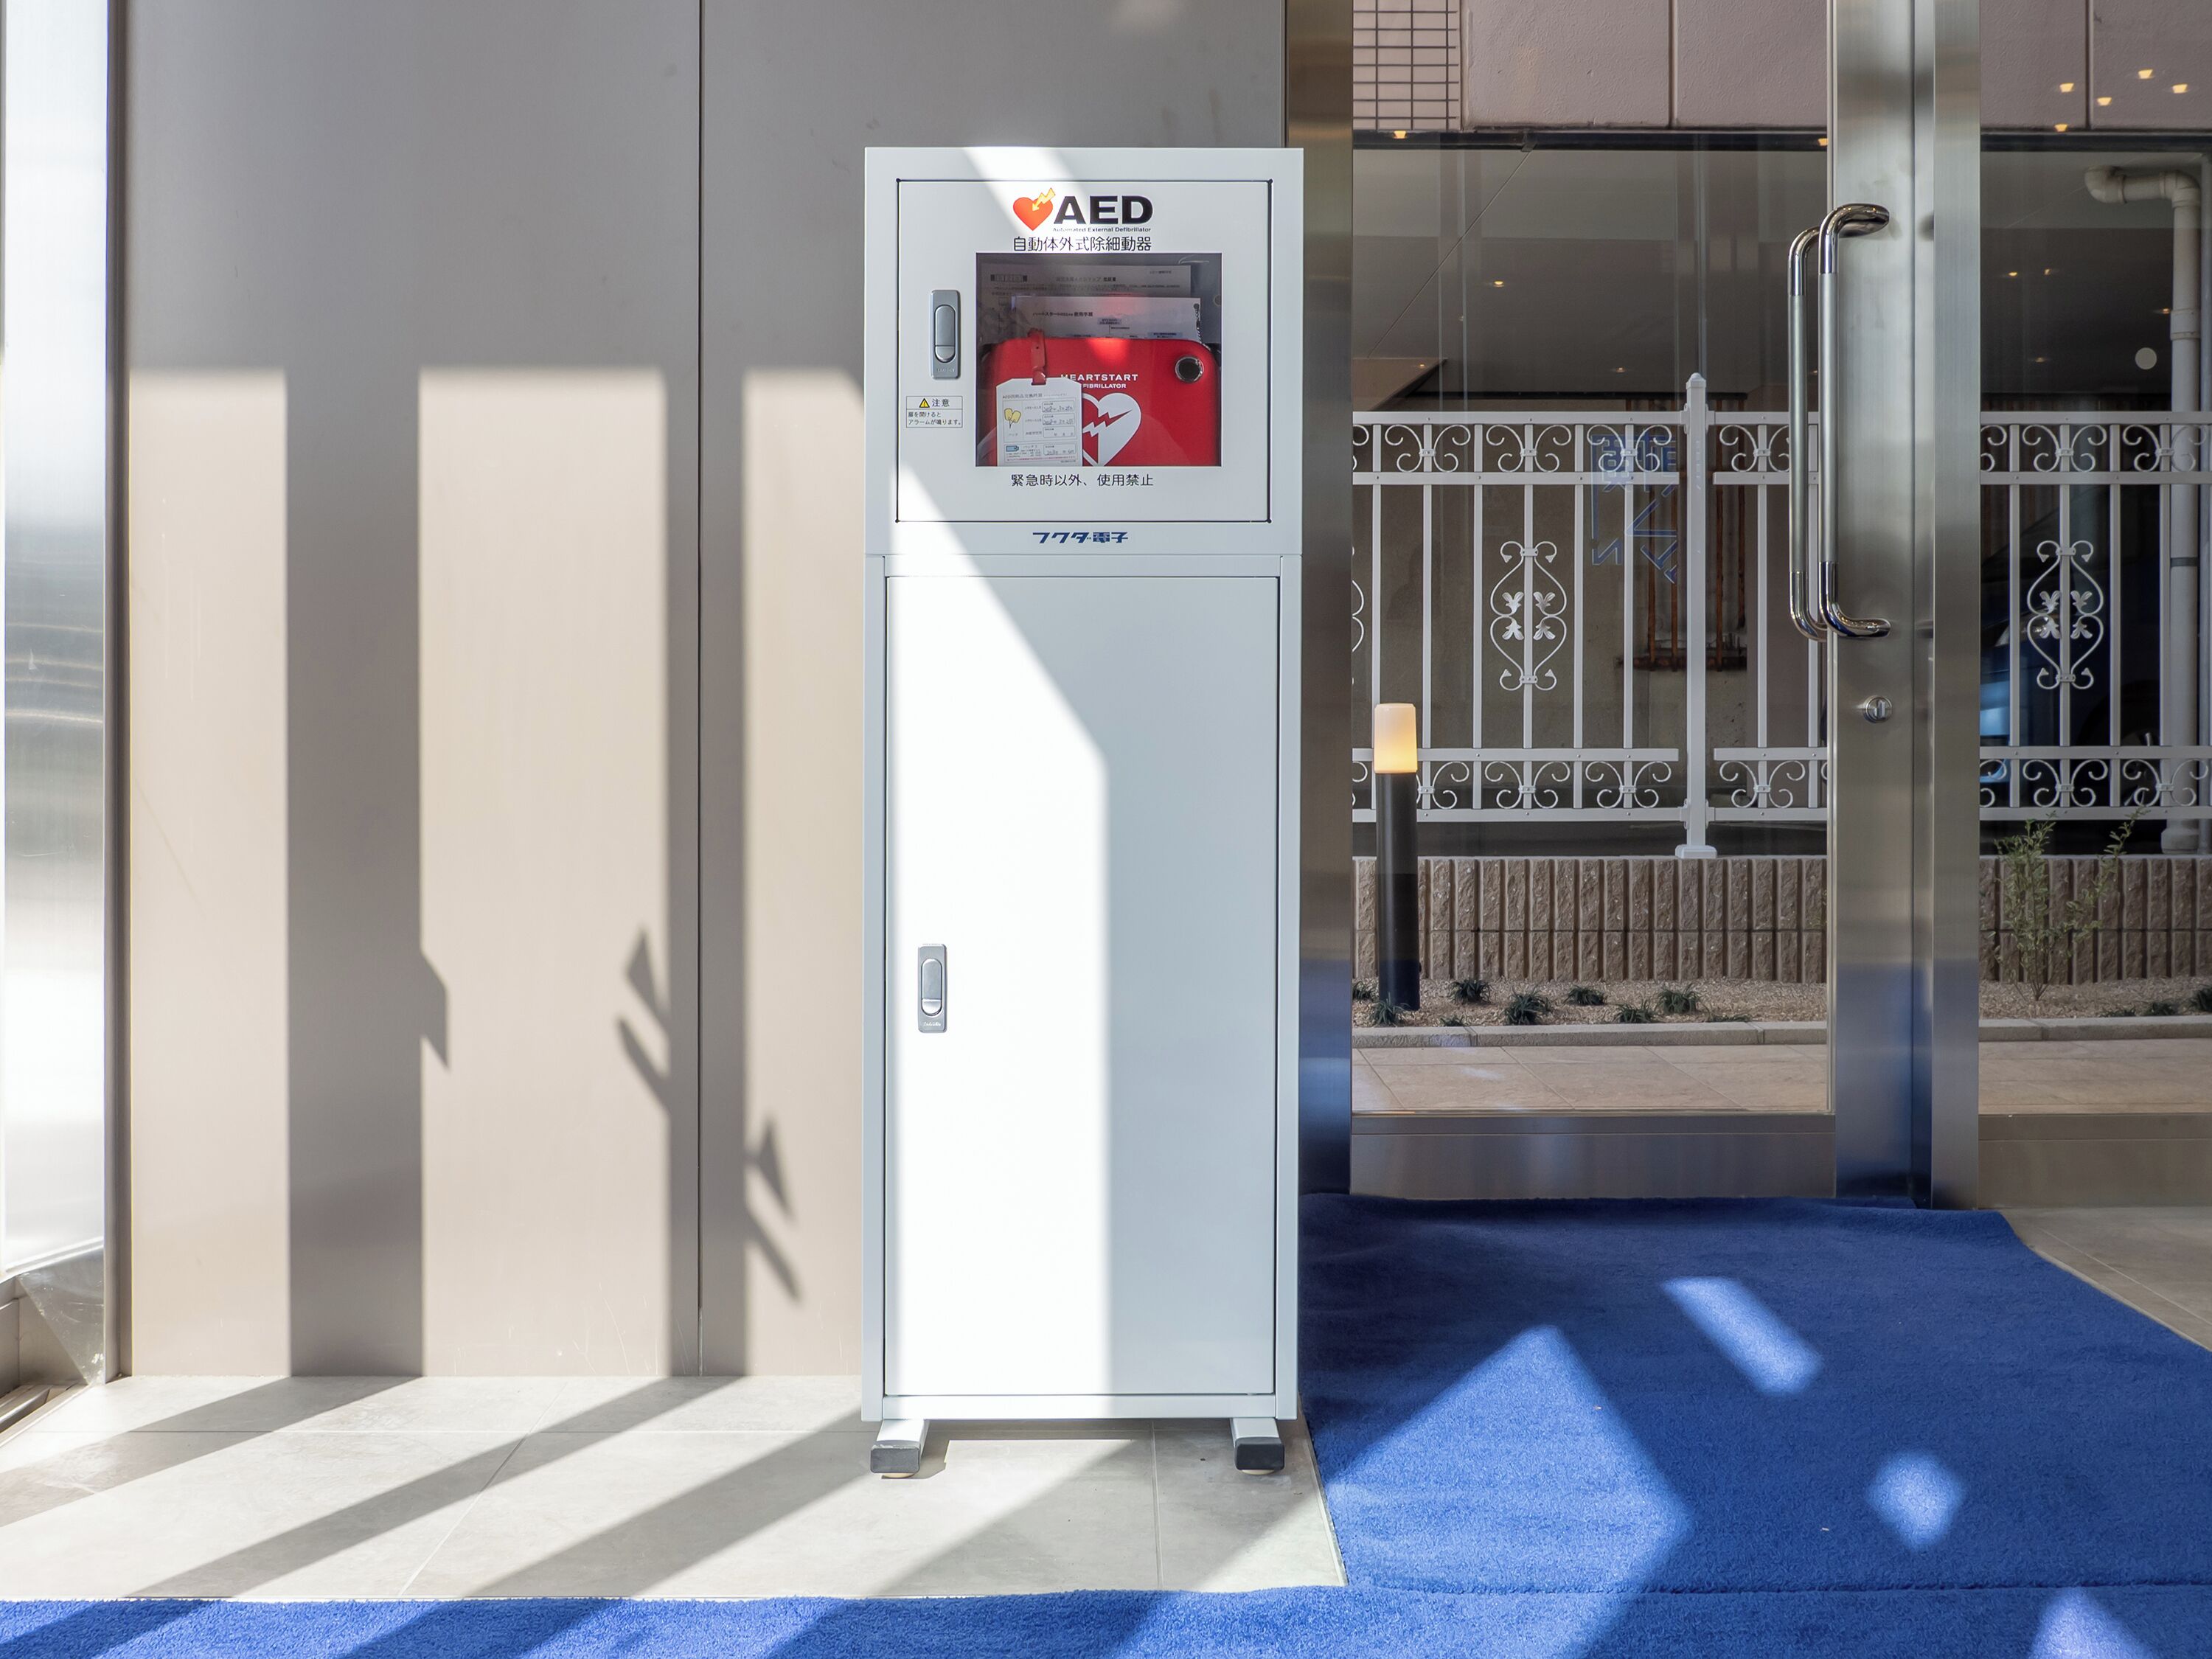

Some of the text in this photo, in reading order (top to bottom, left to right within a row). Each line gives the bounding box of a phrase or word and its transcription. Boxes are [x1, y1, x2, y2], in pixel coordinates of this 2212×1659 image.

[1054, 195, 1153, 225] AED
[1013, 236, 1152, 251] 自動体外式除細動器
[932, 398, 950, 407] 注意
[1011, 473, 1154, 487] 緊急時以外、使用禁止
[1032, 532, 1128, 544] フクダ電子
